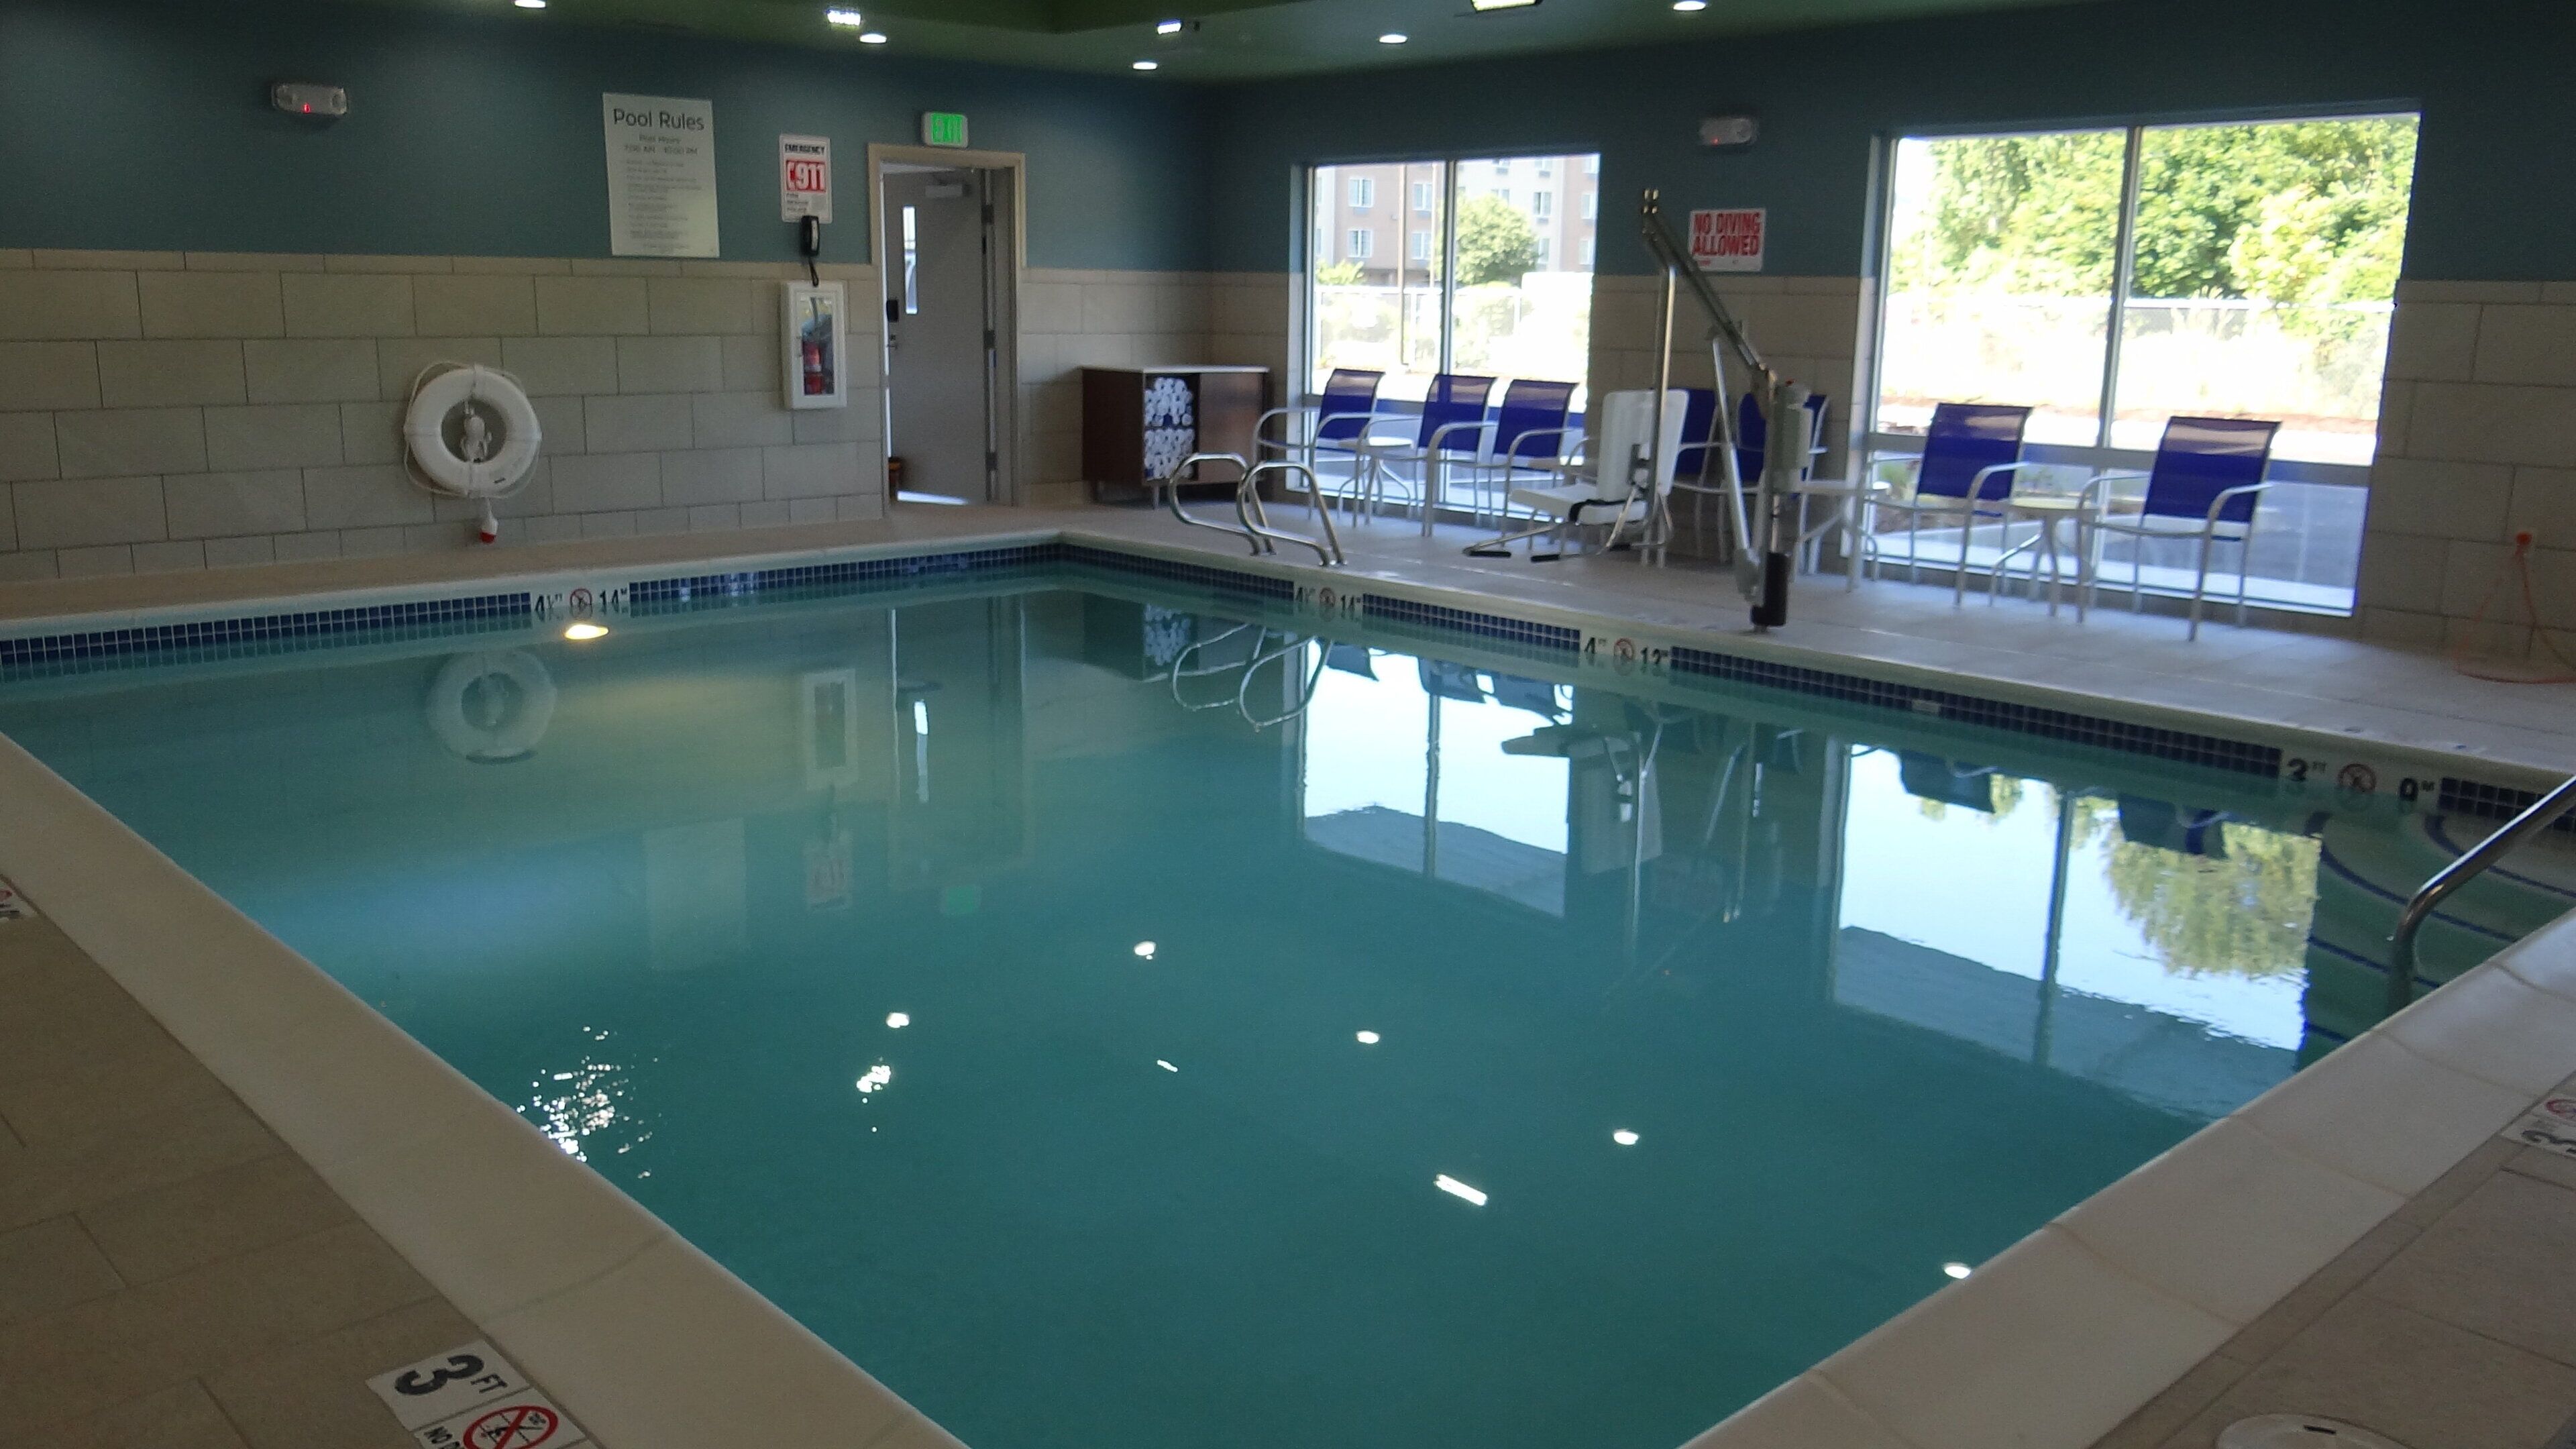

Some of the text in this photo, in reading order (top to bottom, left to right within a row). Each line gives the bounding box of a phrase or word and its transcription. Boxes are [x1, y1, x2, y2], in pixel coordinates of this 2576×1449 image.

[613, 108, 704, 131] Pool Rules
[784, 144, 825, 156] EMERGENCY
[796, 162, 826, 191] 911
[1693, 212, 1761, 235] NO DIVING
[1691, 234, 1760, 256] ALLOWED
[394, 1354, 508, 1396] 3 FT
[423, 1426, 453, 1444] NO
